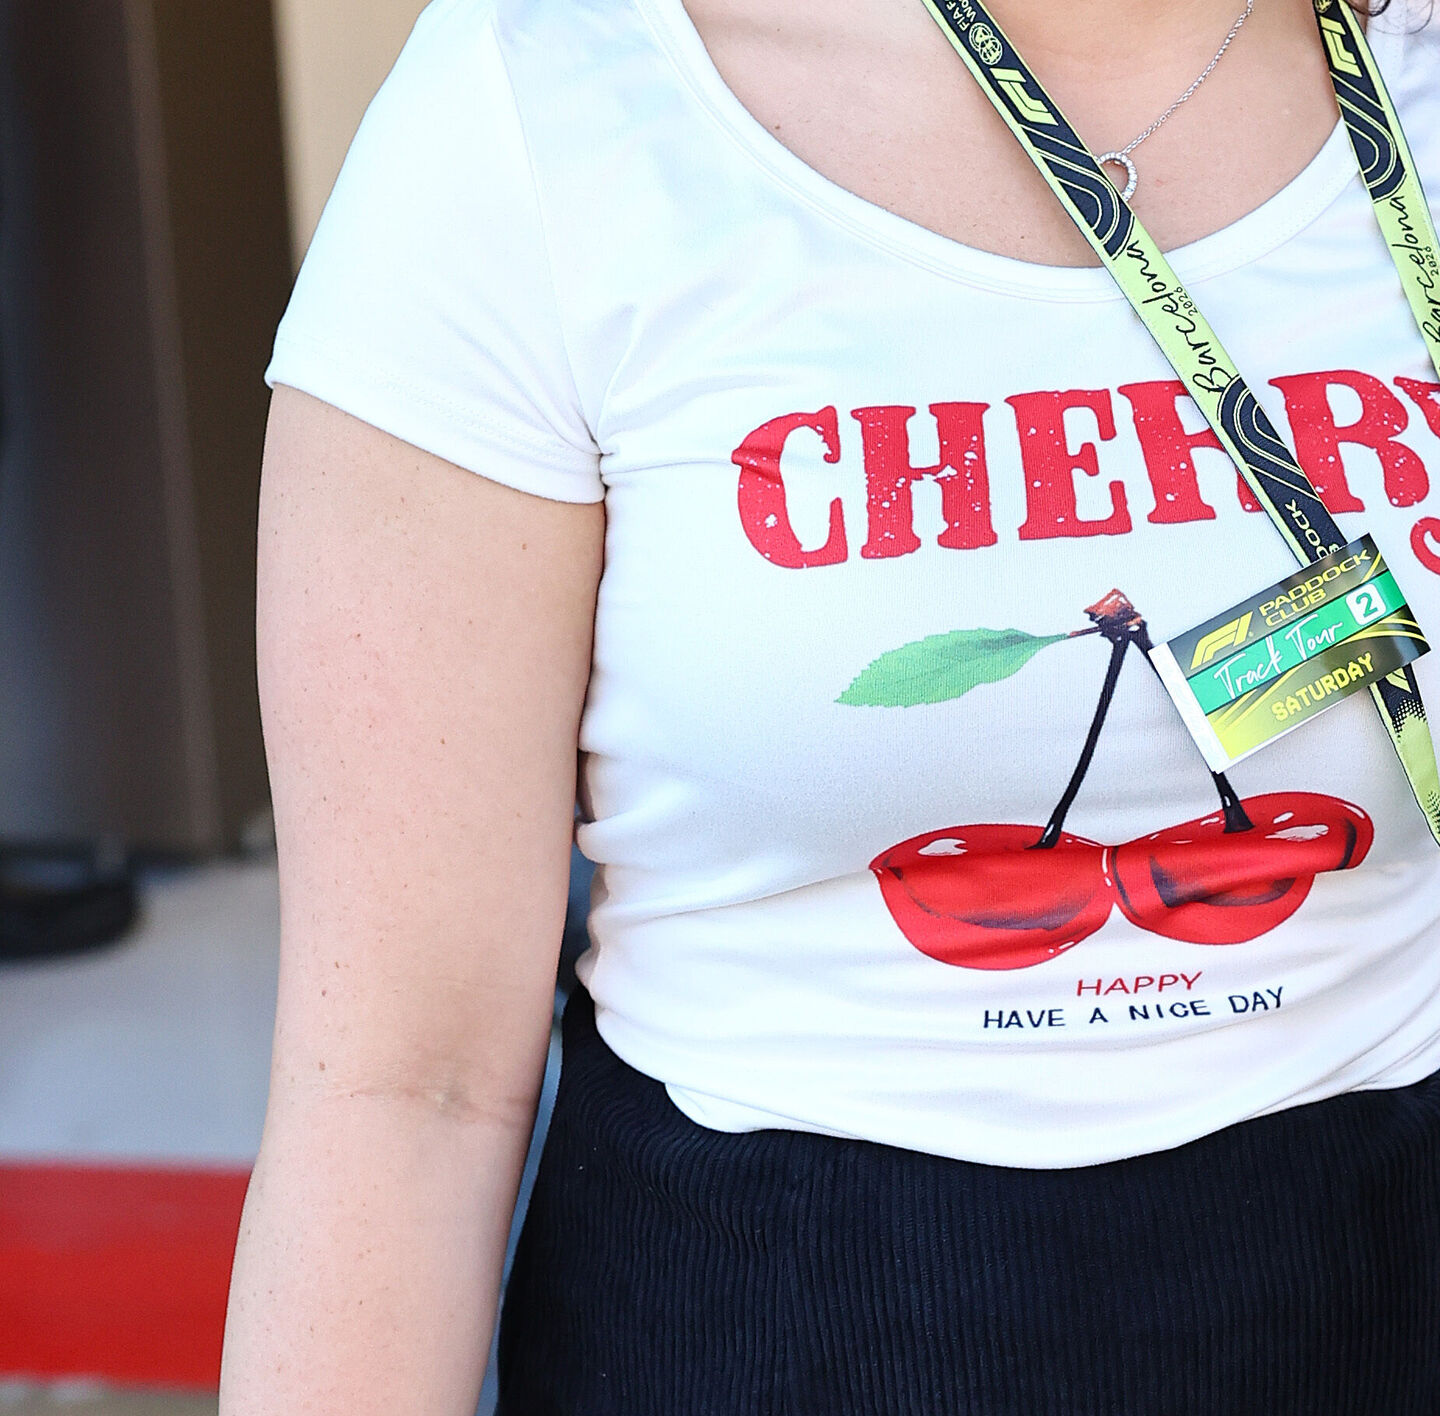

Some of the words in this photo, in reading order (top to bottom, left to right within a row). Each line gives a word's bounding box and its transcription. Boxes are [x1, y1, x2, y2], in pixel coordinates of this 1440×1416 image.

[953, 9, 970, 32] FIA
[1425, 245, 1440, 277] 2026
[1126, 240, 1234, 393] Barcelona
[1173, 286, 1198, 316] 2026
[1259, 549, 1371, 617] PADDOCK
[1264, 588, 1327, 627] CLUB
[1355, 591, 1378, 619] 2
[1213, 634, 1284, 701] Track
[1285, 613, 1343, 661] Tour
[1271, 652, 1375, 722] SATURDAY
[1076, 971, 1203, 997] HAPPY
[983, 1009, 1066, 1029] HAVE
[1088, 1007, 1109, 1024] A
[1128, 1000, 1211, 1021] NICE
[1228, 986, 1284, 1014] DAY
